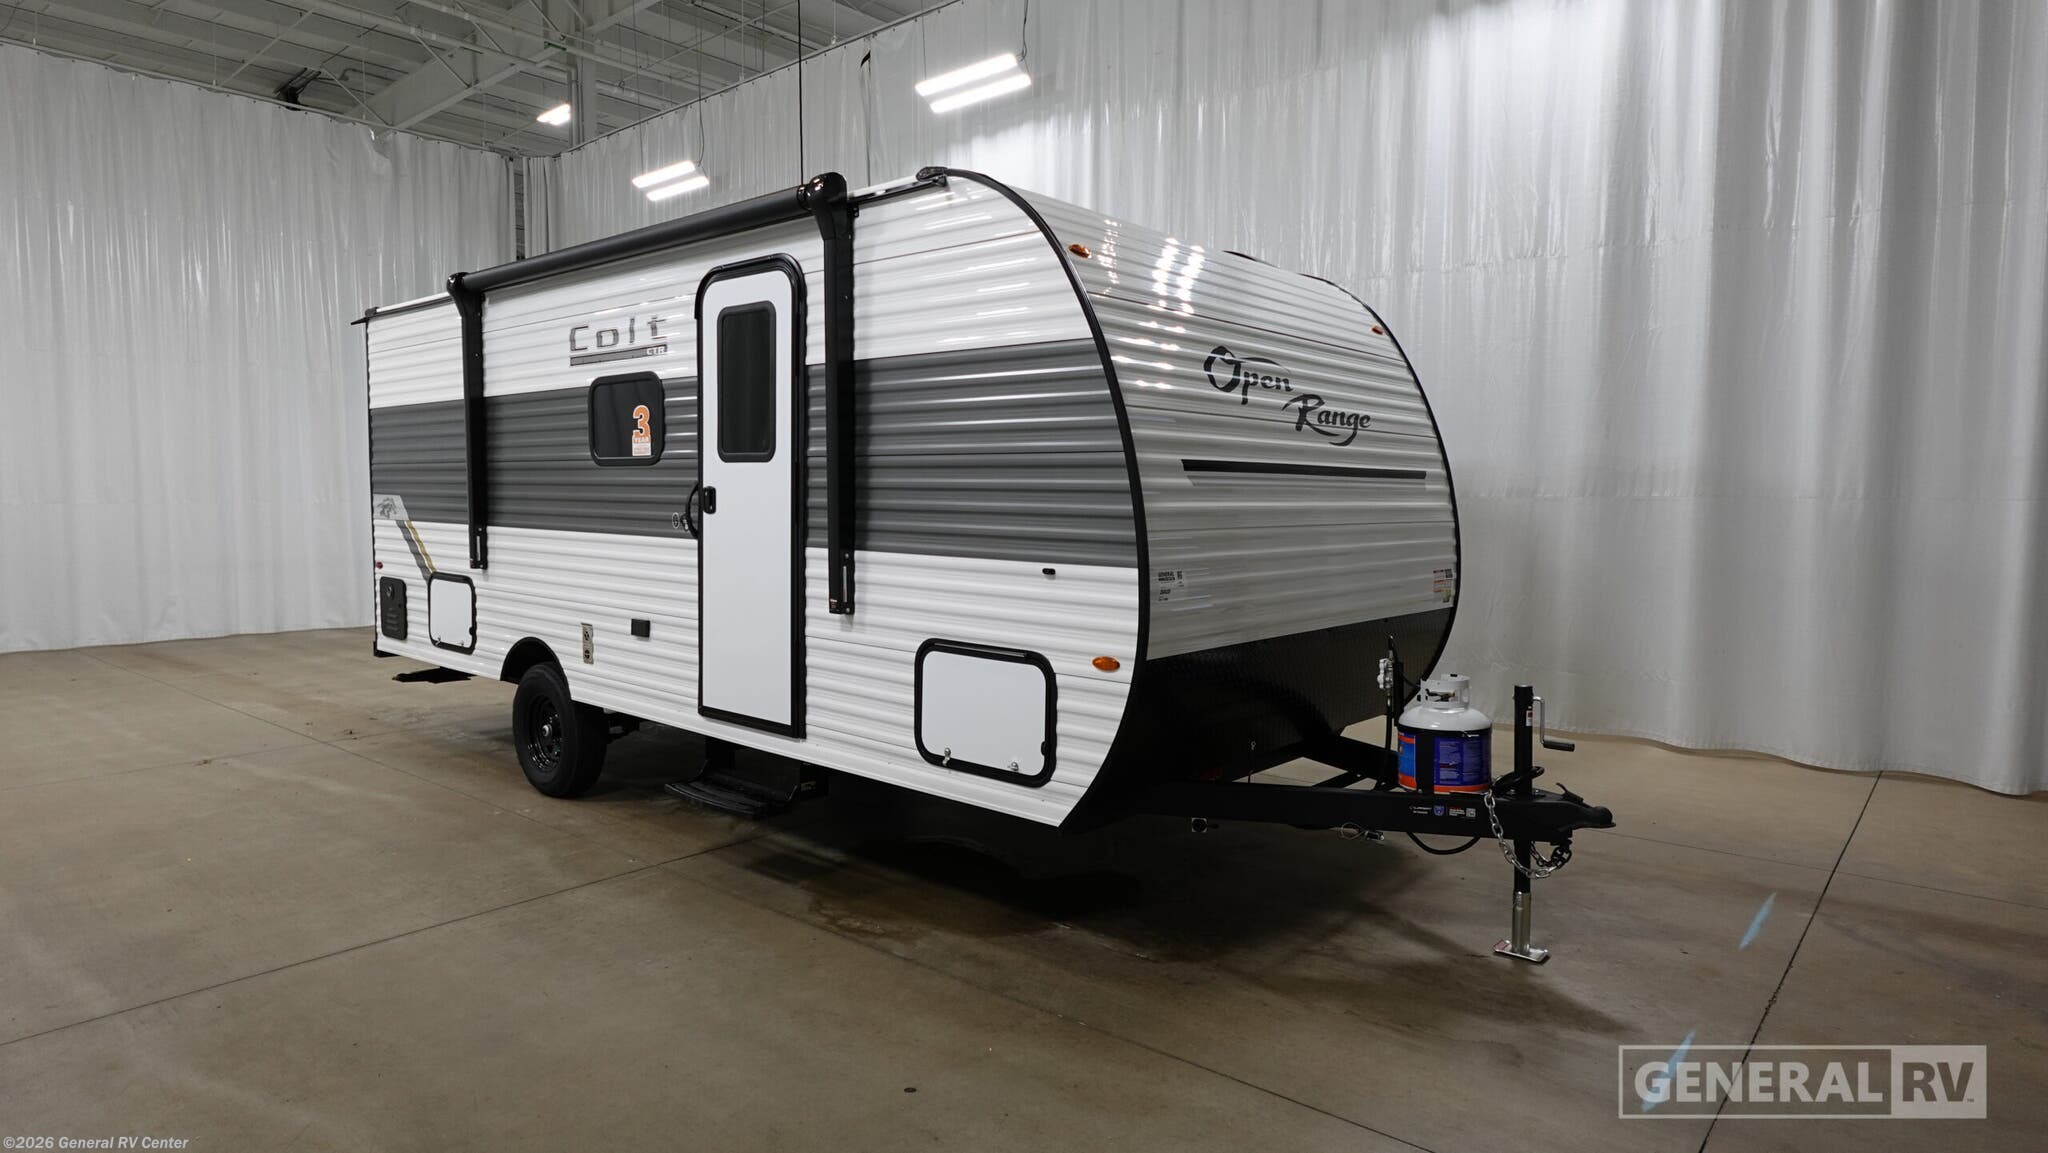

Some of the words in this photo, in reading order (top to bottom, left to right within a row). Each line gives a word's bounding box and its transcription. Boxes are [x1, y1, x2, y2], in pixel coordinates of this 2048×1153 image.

[569, 316, 668, 352] Colt
[1203, 345, 1294, 405] Open
[632, 404, 651, 438] 3
[1281, 393, 1372, 447] Range
